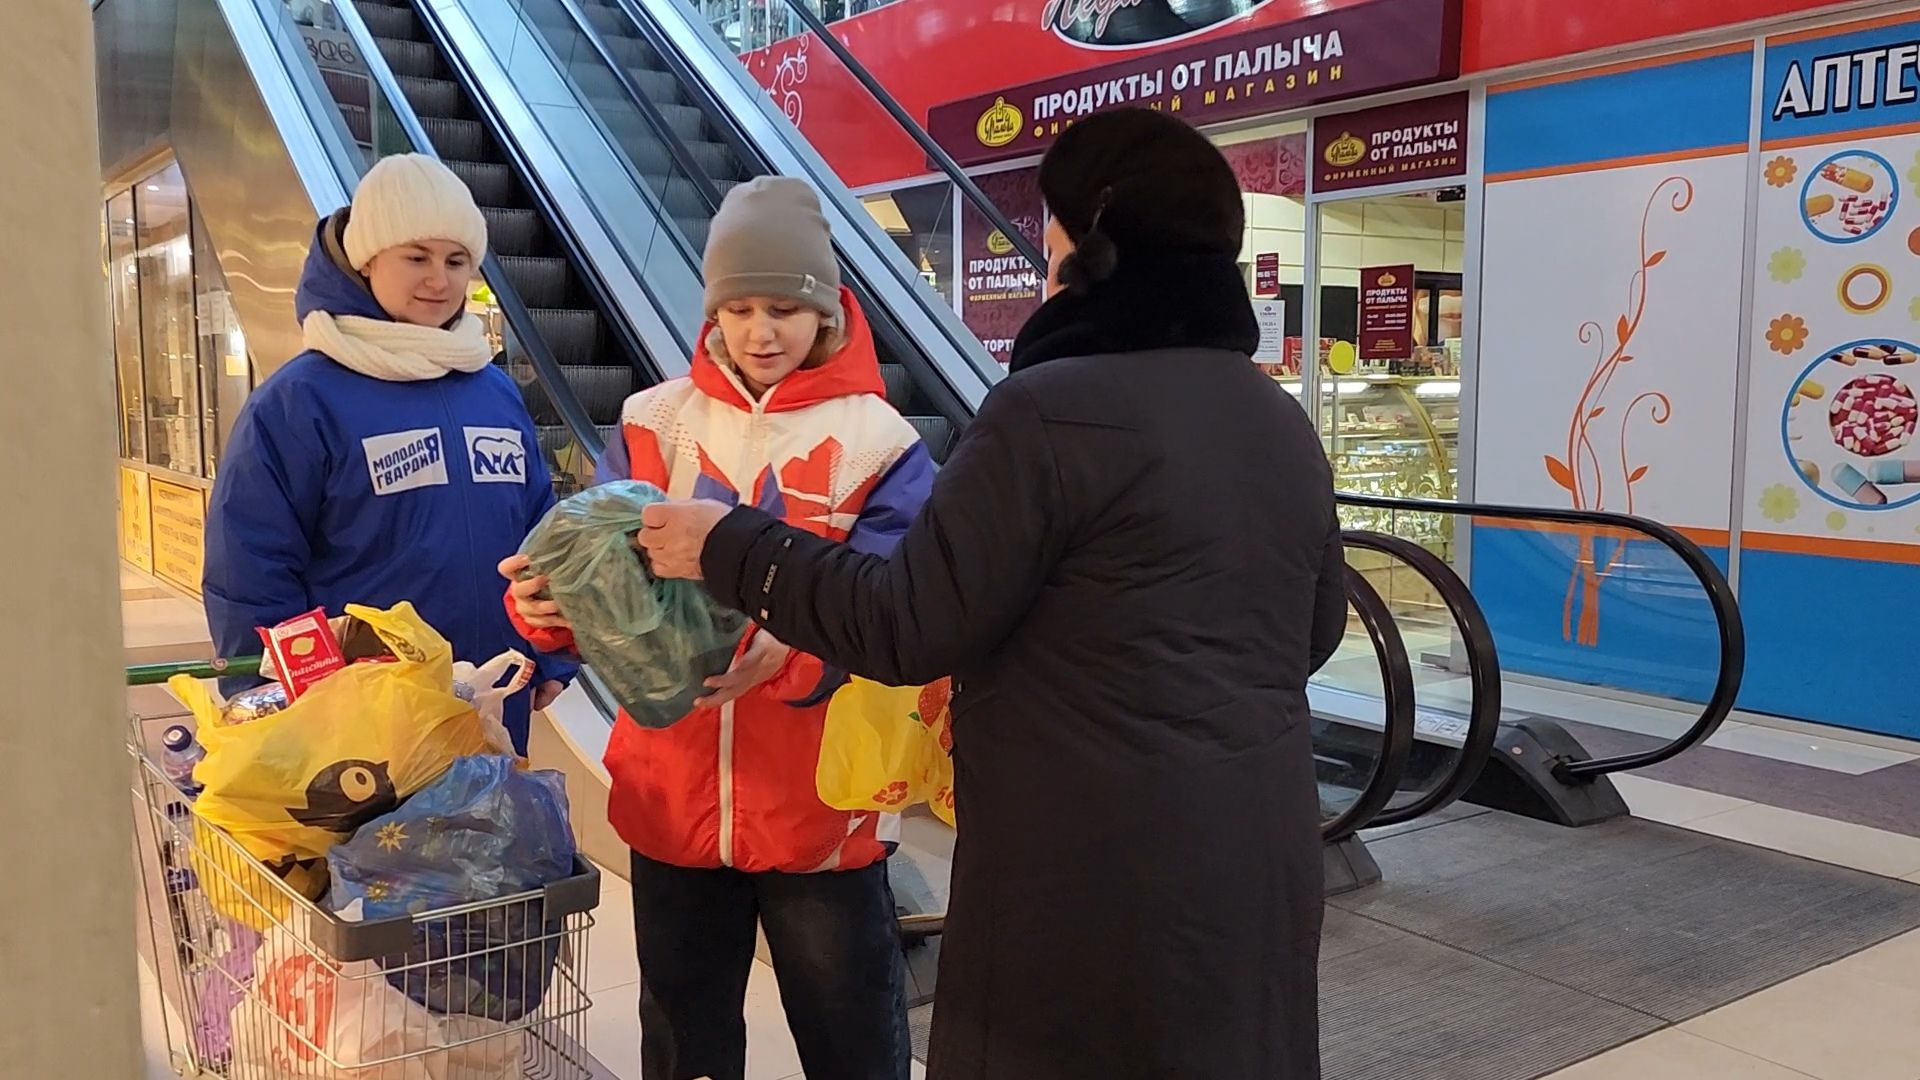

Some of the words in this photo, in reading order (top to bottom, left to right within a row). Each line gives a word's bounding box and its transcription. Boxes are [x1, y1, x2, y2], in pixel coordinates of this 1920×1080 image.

[1033, 69, 1163, 121] ПРОДУКТЫ
[1171, 60, 1206, 91] ОТ
[1213, 30, 1344, 83] ПАЛЫЧА
[1204, 64, 1342, 105] МАГАЗИН
[1773, 42, 1920, 118] АПТЕ
[1371, 120, 1459, 146] ПРОДУКТЫ
[1370, 147, 1389, 162] ОТ
[1393, 137, 1458, 159] ПАЛЫЧА
[1323, 164, 1395, 181] ФИРМЕННЫЙ
[1401, 156, 1458, 172] МАГАЗИН
[968, 276, 984, 290] ОТ
[986, 271, 1037, 289] ПАЛЫЧА
[1366, 287, 1408, 297] ПРОДУКТЫ
[1365, 297, 1375, 305] ОТ
